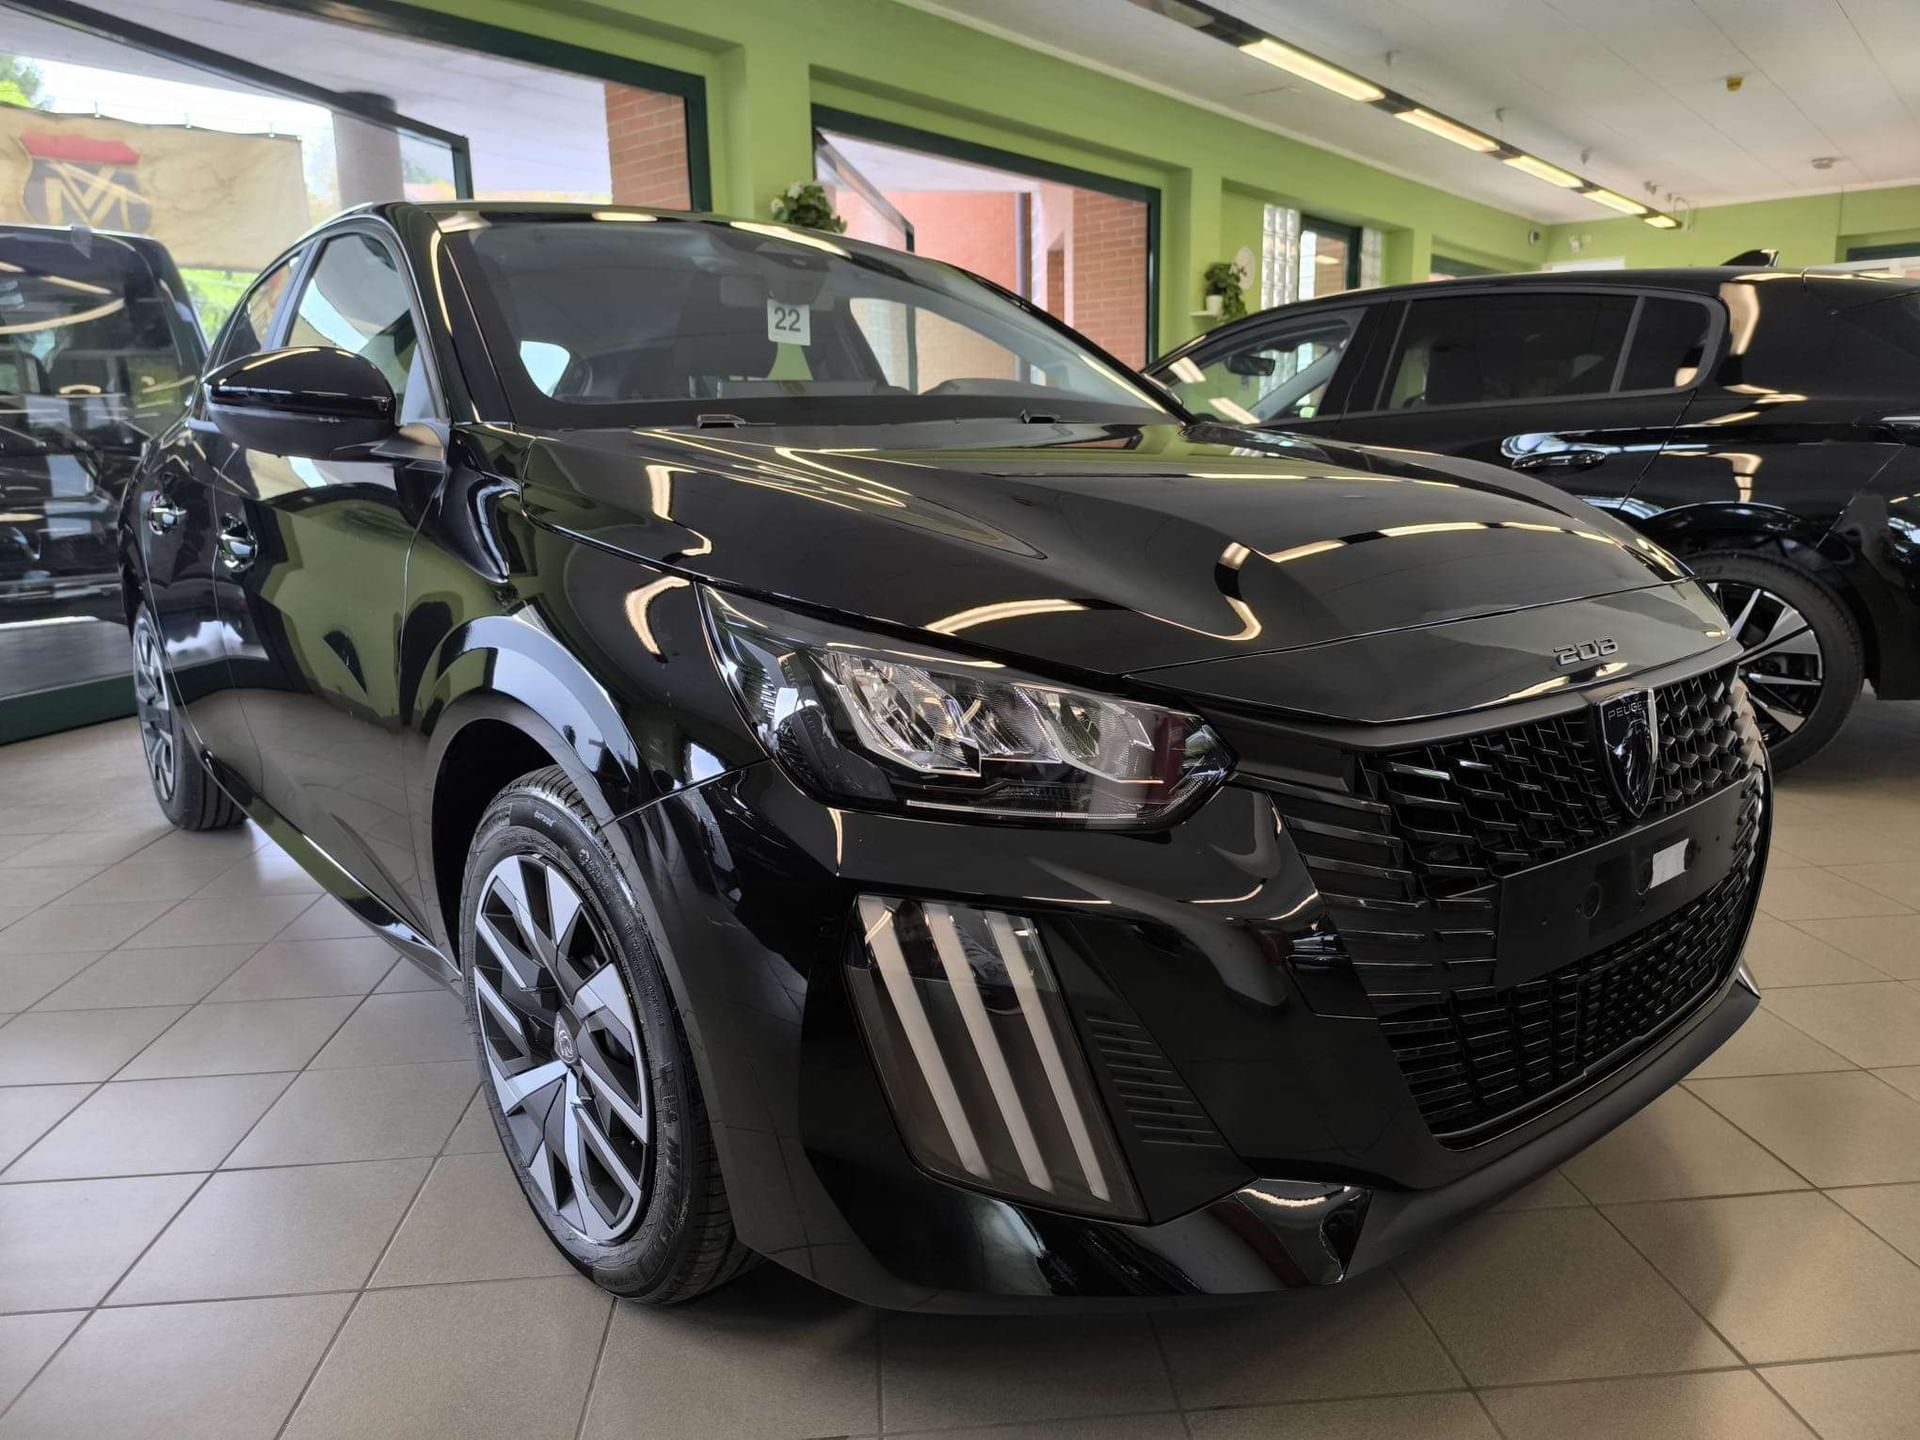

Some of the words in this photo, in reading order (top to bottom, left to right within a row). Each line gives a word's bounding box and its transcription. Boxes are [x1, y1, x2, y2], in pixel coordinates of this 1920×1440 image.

[774, 306, 801, 332] 22
[1553, 638, 1618, 666] 208
[1607, 700, 1648, 720] PEUGE
